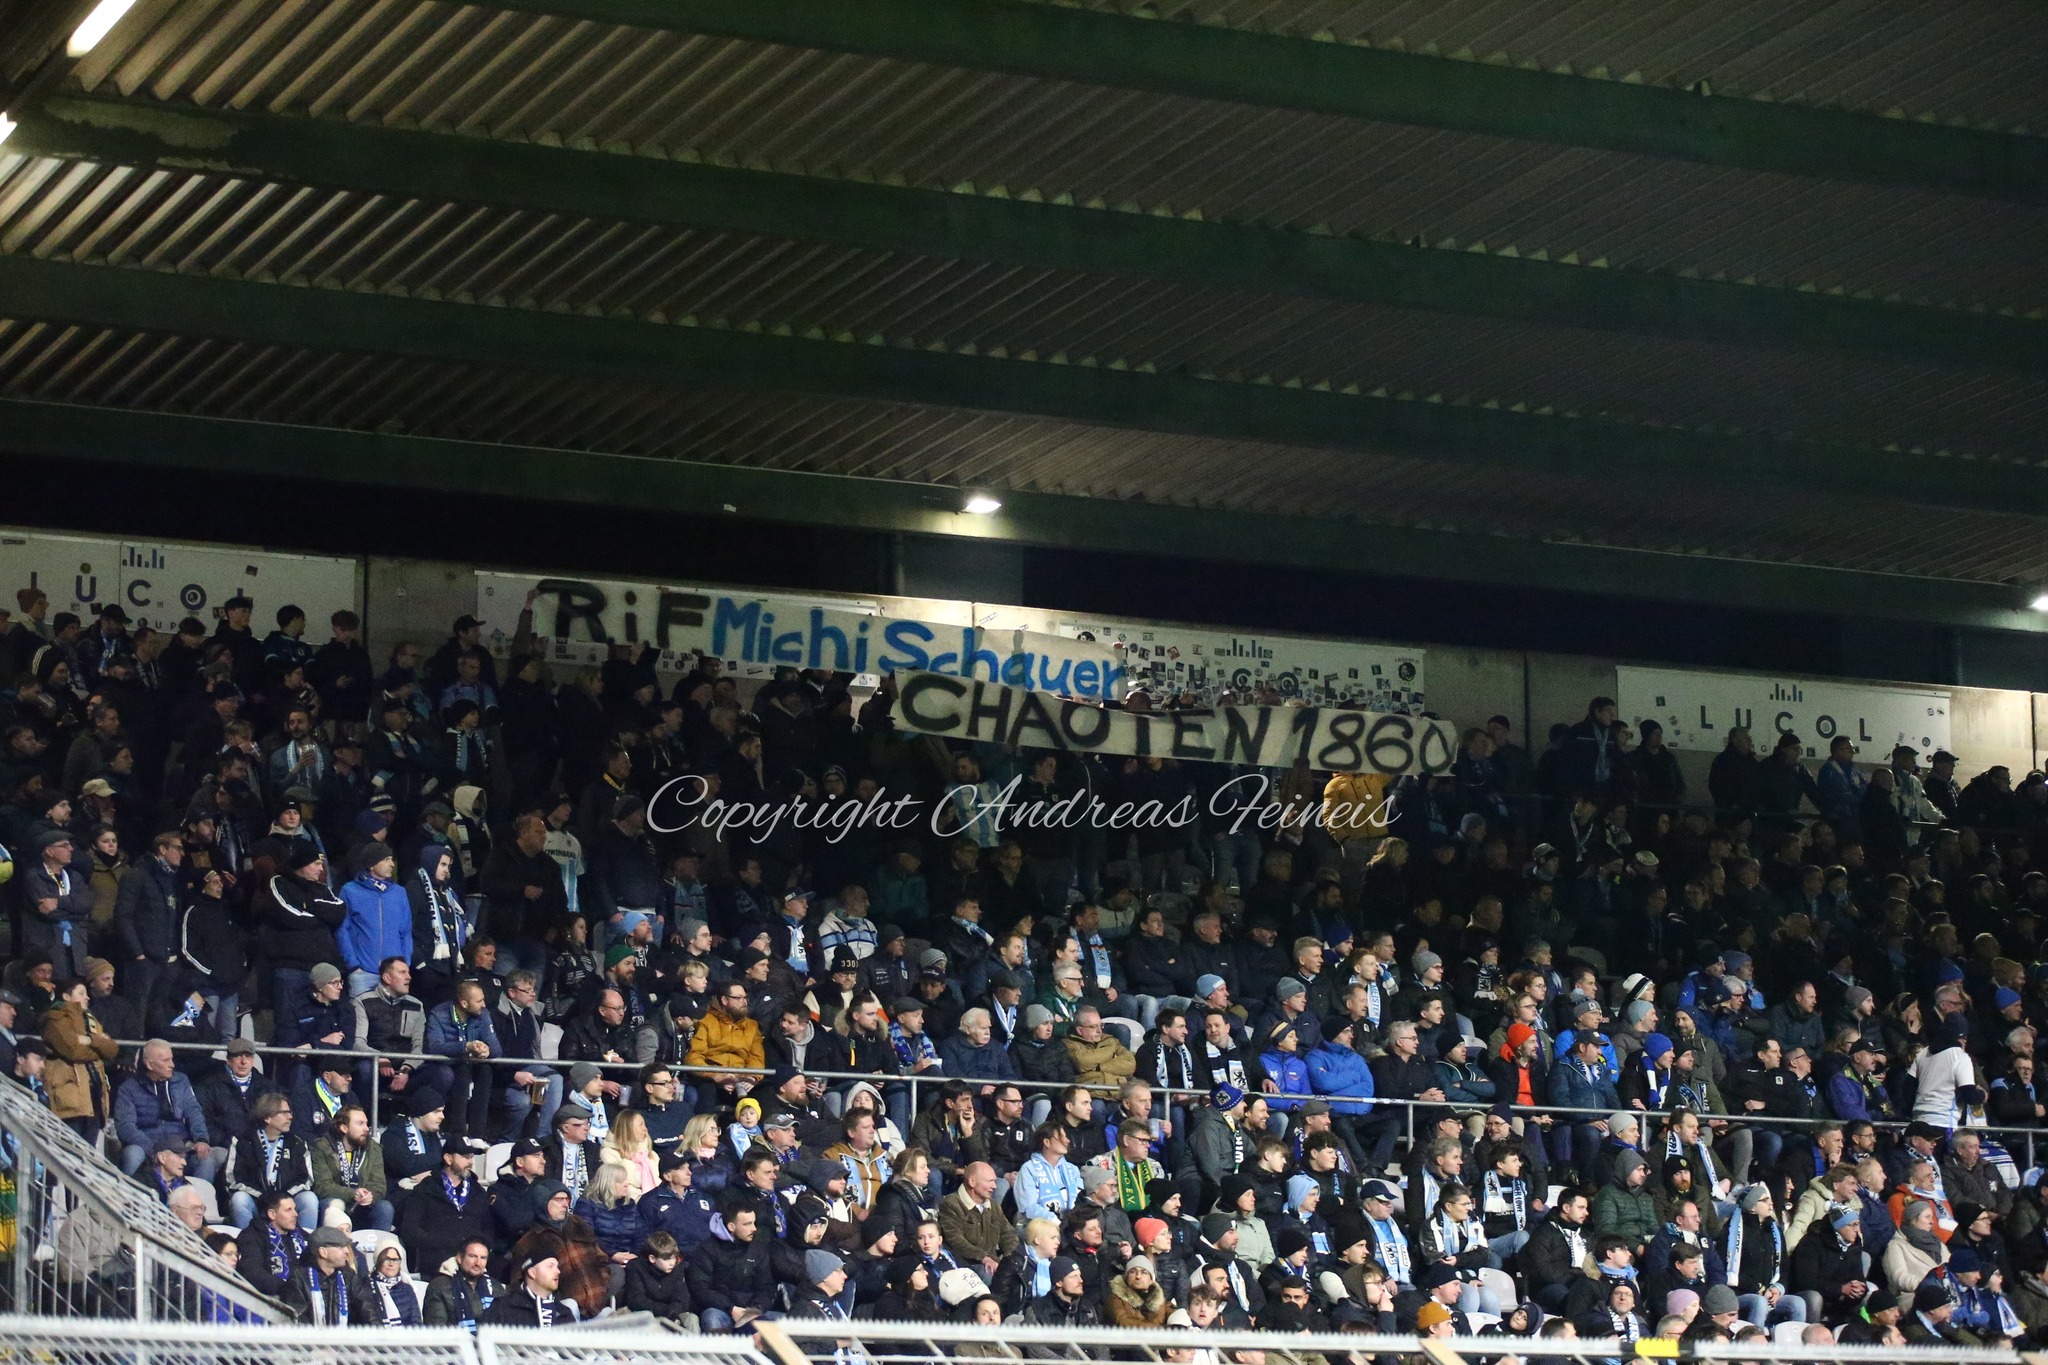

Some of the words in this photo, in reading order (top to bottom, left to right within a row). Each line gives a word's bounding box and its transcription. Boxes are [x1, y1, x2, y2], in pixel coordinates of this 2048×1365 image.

[713, 597, 868, 673] Michi
[878, 620, 1127, 700] Schauer
[901, 674, 1273, 764] CHAOTEN
[1293, 707, 1453, 774] 1860
[1701, 705, 1872, 742] LUCOL
